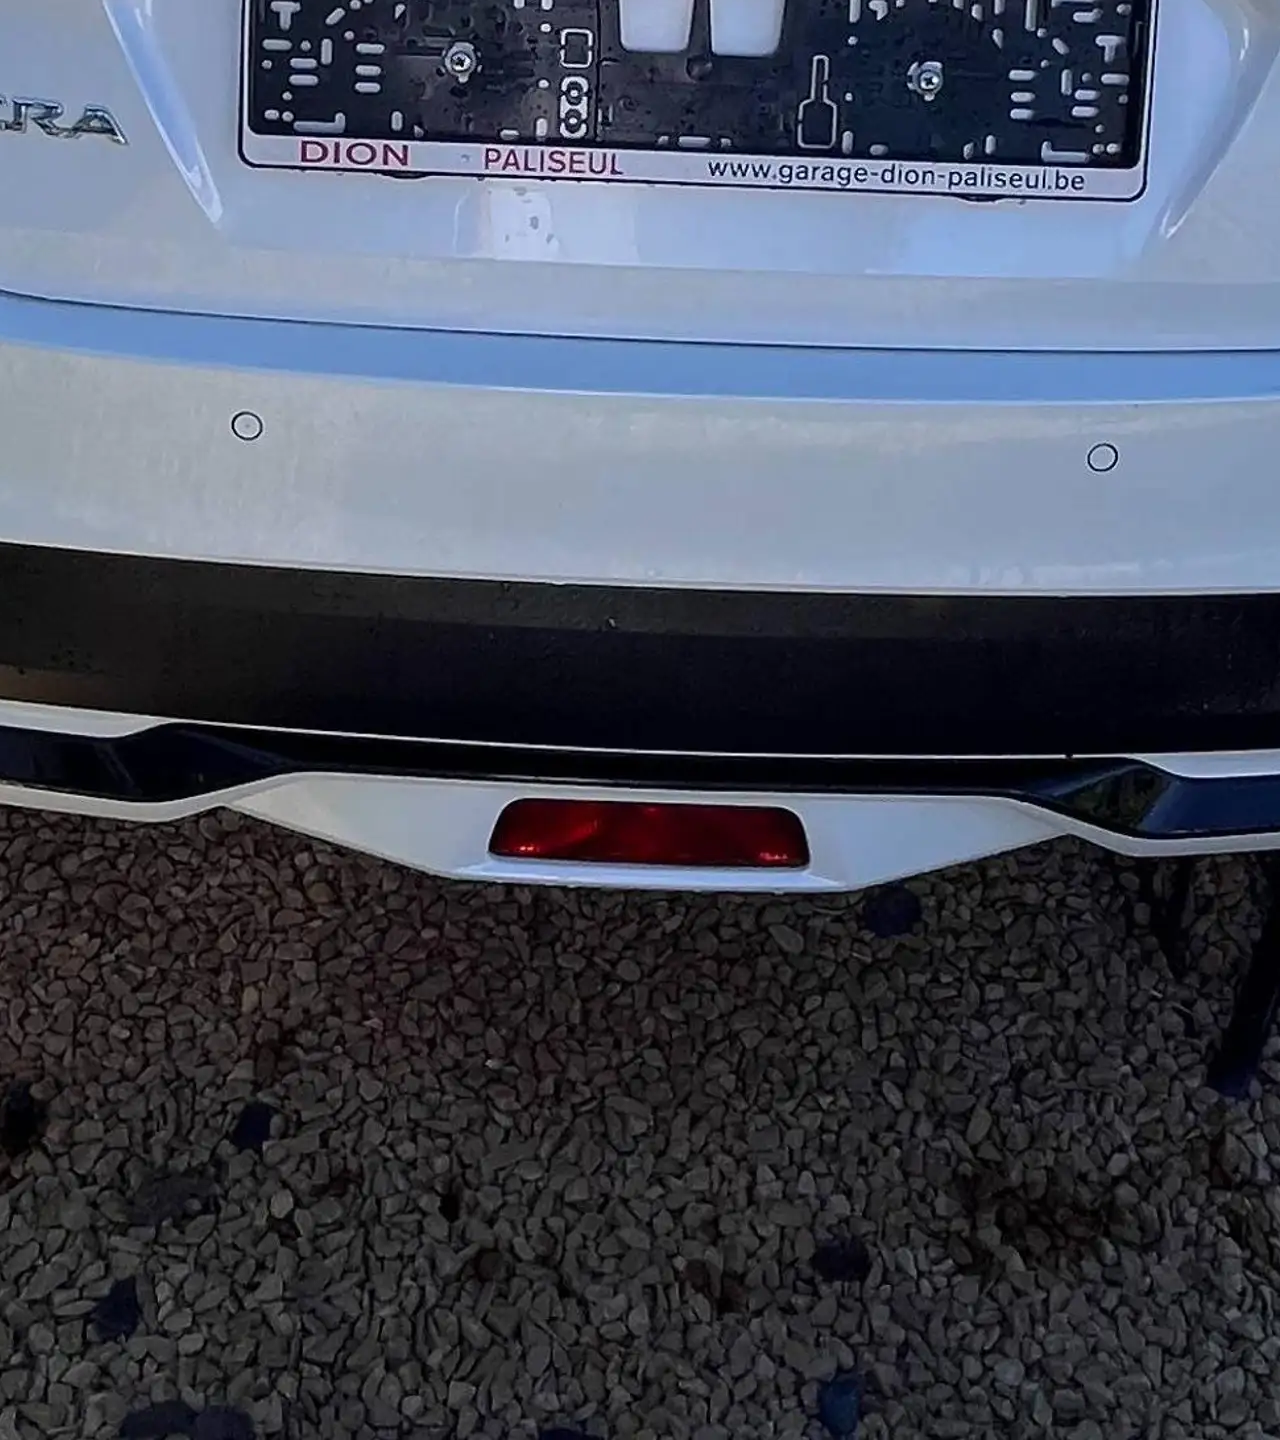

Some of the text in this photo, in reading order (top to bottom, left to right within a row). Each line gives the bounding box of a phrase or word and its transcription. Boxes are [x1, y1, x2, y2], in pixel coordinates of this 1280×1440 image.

[300, 139, 1086, 192] DION PALISEUL www.garage-dion-paliseul.be
